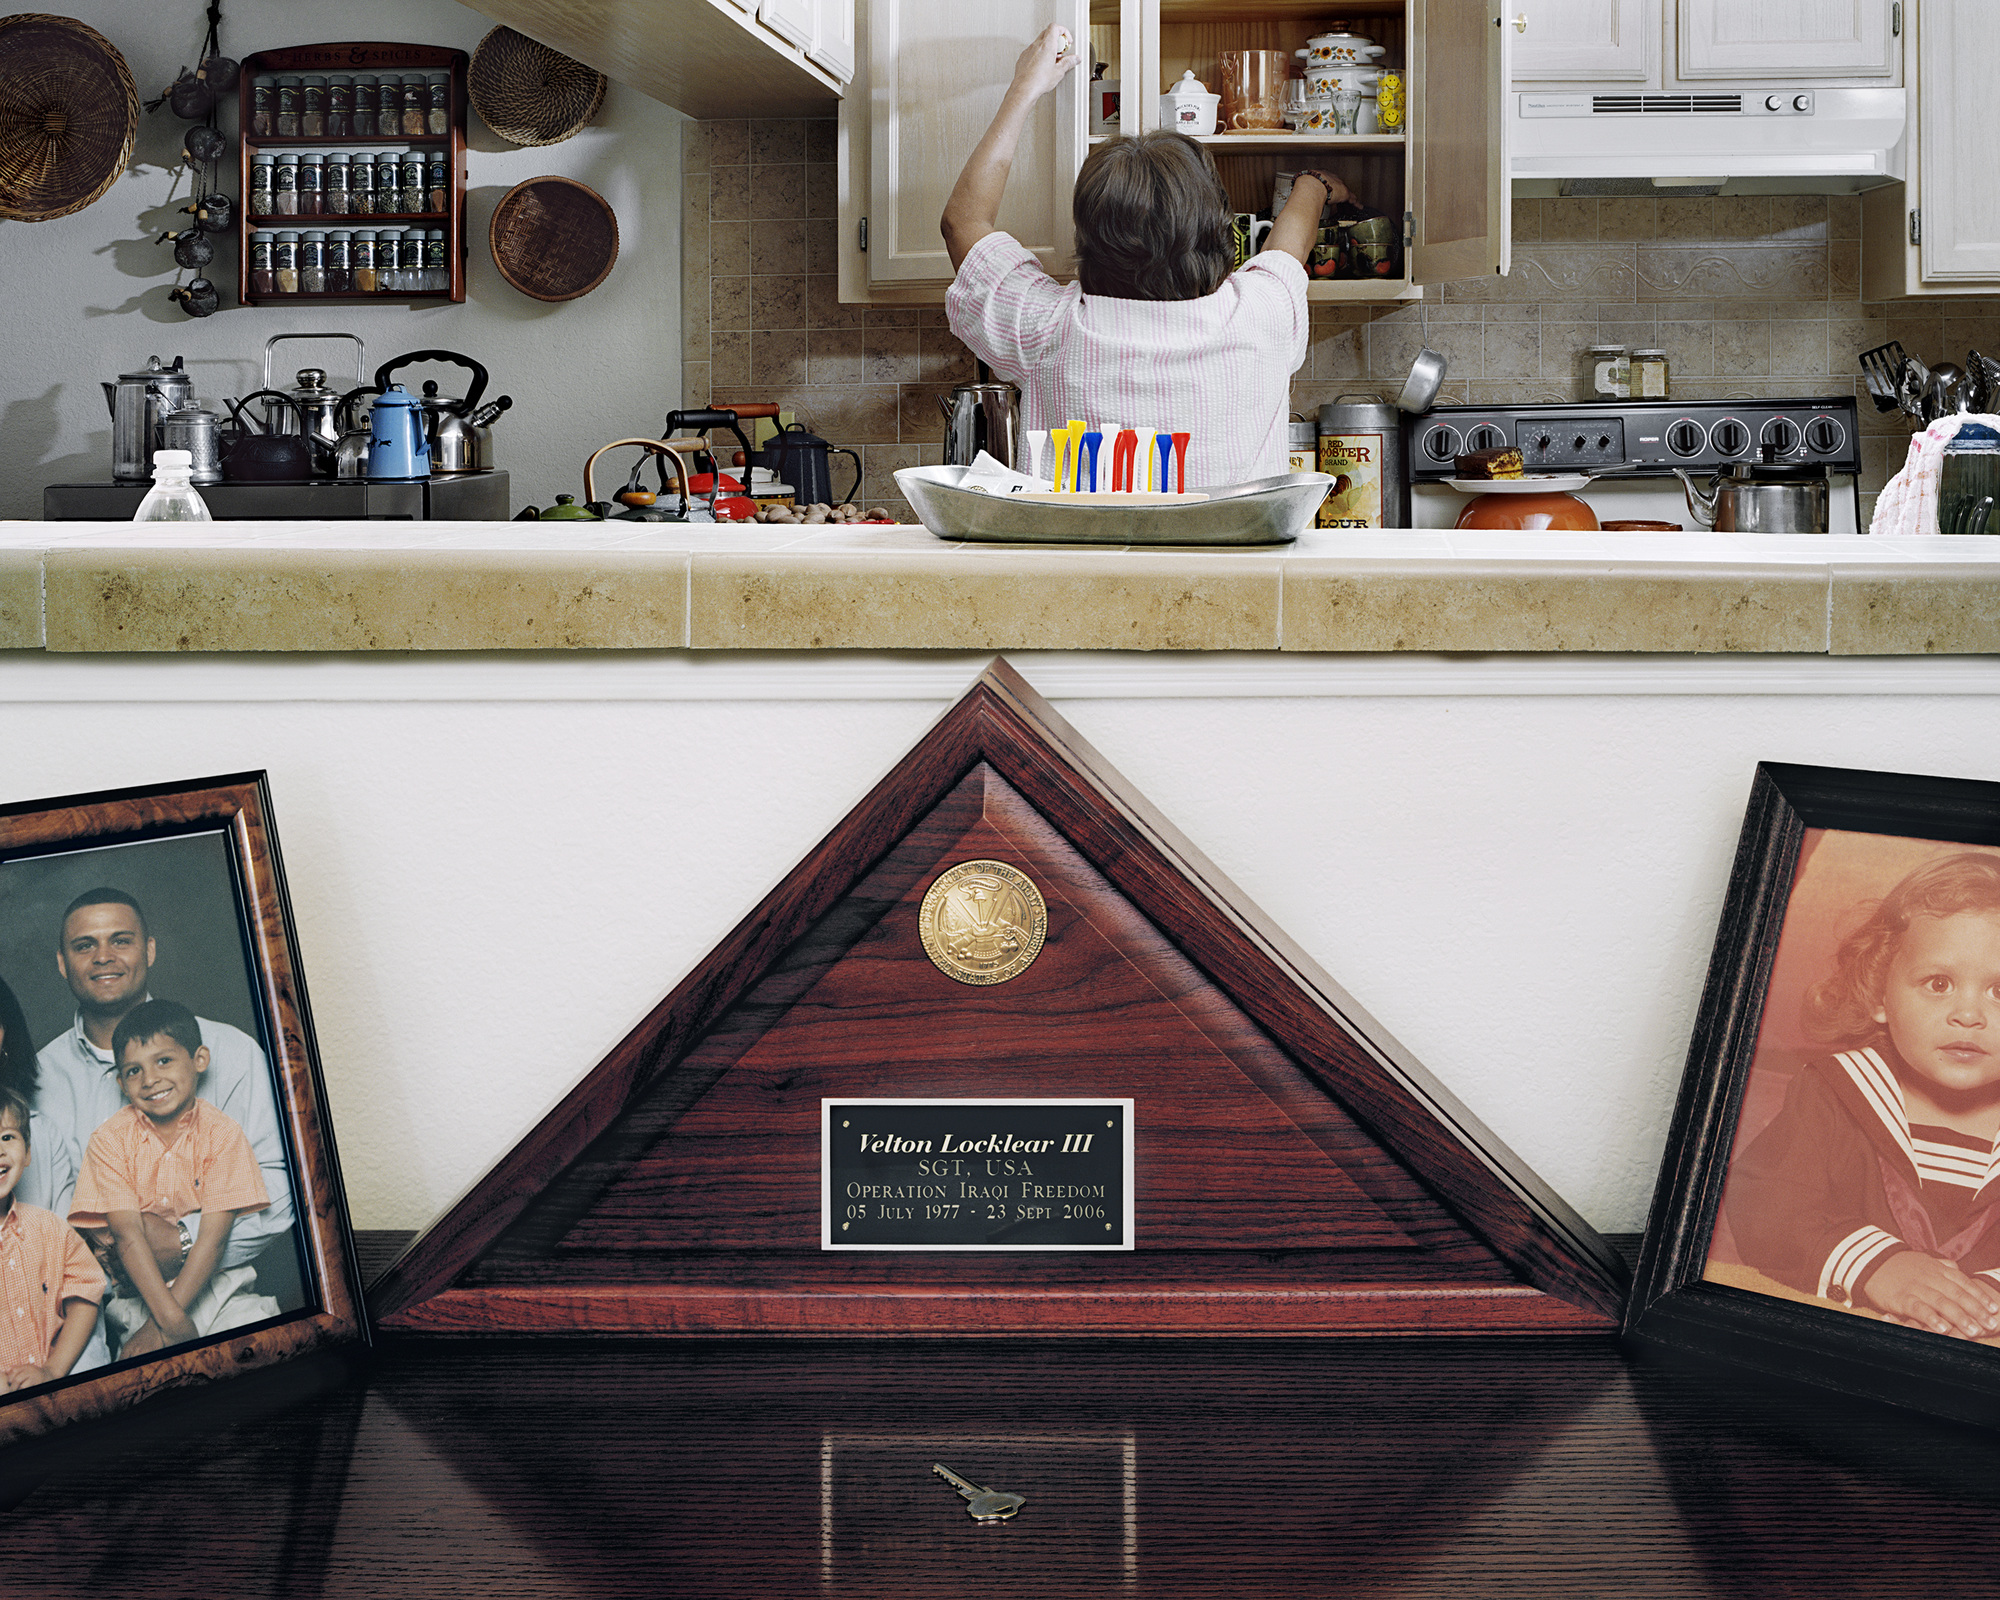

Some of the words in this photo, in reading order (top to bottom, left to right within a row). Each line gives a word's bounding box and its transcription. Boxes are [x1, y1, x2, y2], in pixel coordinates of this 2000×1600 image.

[293, 52, 341, 62] HERBS
[349, 47, 368, 64] &
[373, 50, 421, 61] SPICES
[1328, 440, 1344, 448] RED
[921, 864, 973, 923] DEPARTMENT
[975, 864, 992, 873] OF
[993, 865, 1016, 880] THE
[1016, 878, 1042, 907] ARMY
[922, 933, 953, 973] UNITED
[954, 969, 999, 983] STATES
[1003, 964, 1018, 978] OF
[1019, 917, 1043, 968] AMERICA
[860, 1133, 932, 1154] Velton
[939, 1133, 1055, 1154] Locklear
[1060, 1133, 1095, 1153] III
[917, 1159, 971, 1178] SGT,
[986, 1159, 1034, 1176] USA
[846, 1182, 947, 1199] OPERATION
[960, 1182, 1009, 1201] IRAQI
[1021, 1182, 1105, 1199] FREEDOM
[846, 1204, 867, 1220] 05
[877, 1204, 914, 1220] JULY
[925, 1204, 960, 1220] 1977
[986, 1204, 1006, 1220] 23
[1017, 1204, 1052, 1220] SEPT
[1063, 1204, 1105, 1220] 2006
